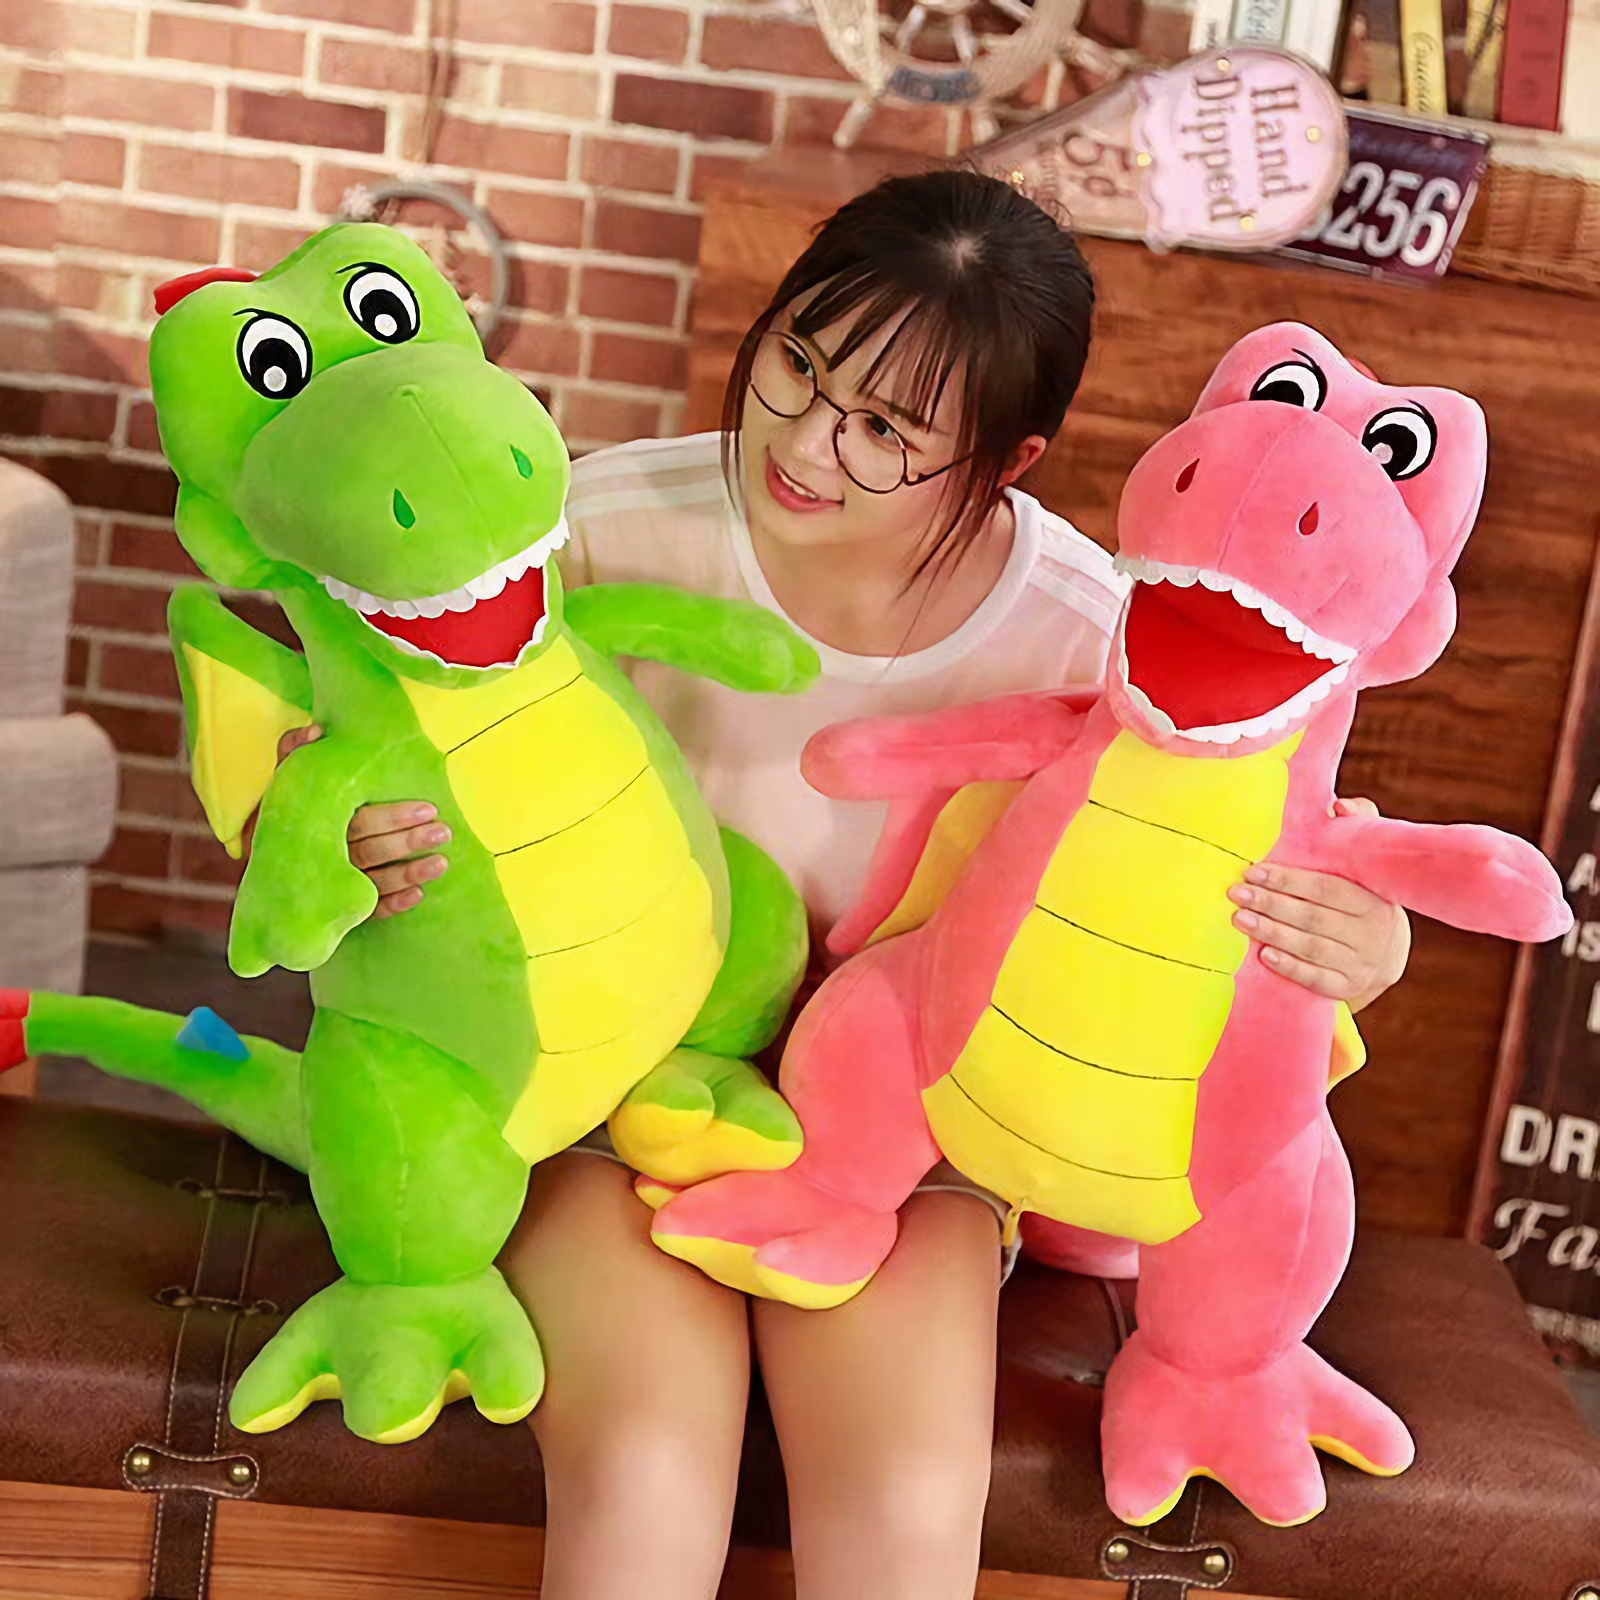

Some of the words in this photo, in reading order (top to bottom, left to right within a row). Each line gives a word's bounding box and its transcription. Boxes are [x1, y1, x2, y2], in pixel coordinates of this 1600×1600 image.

[1180, 75, 1258, 222] Dipped
[1250, 83, 1308, 198] Hand
[1298, 160, 1463, 268] 256
[1499, 1103, 1600, 1182] DR
[1493, 1197, 1600, 1277] Fa
